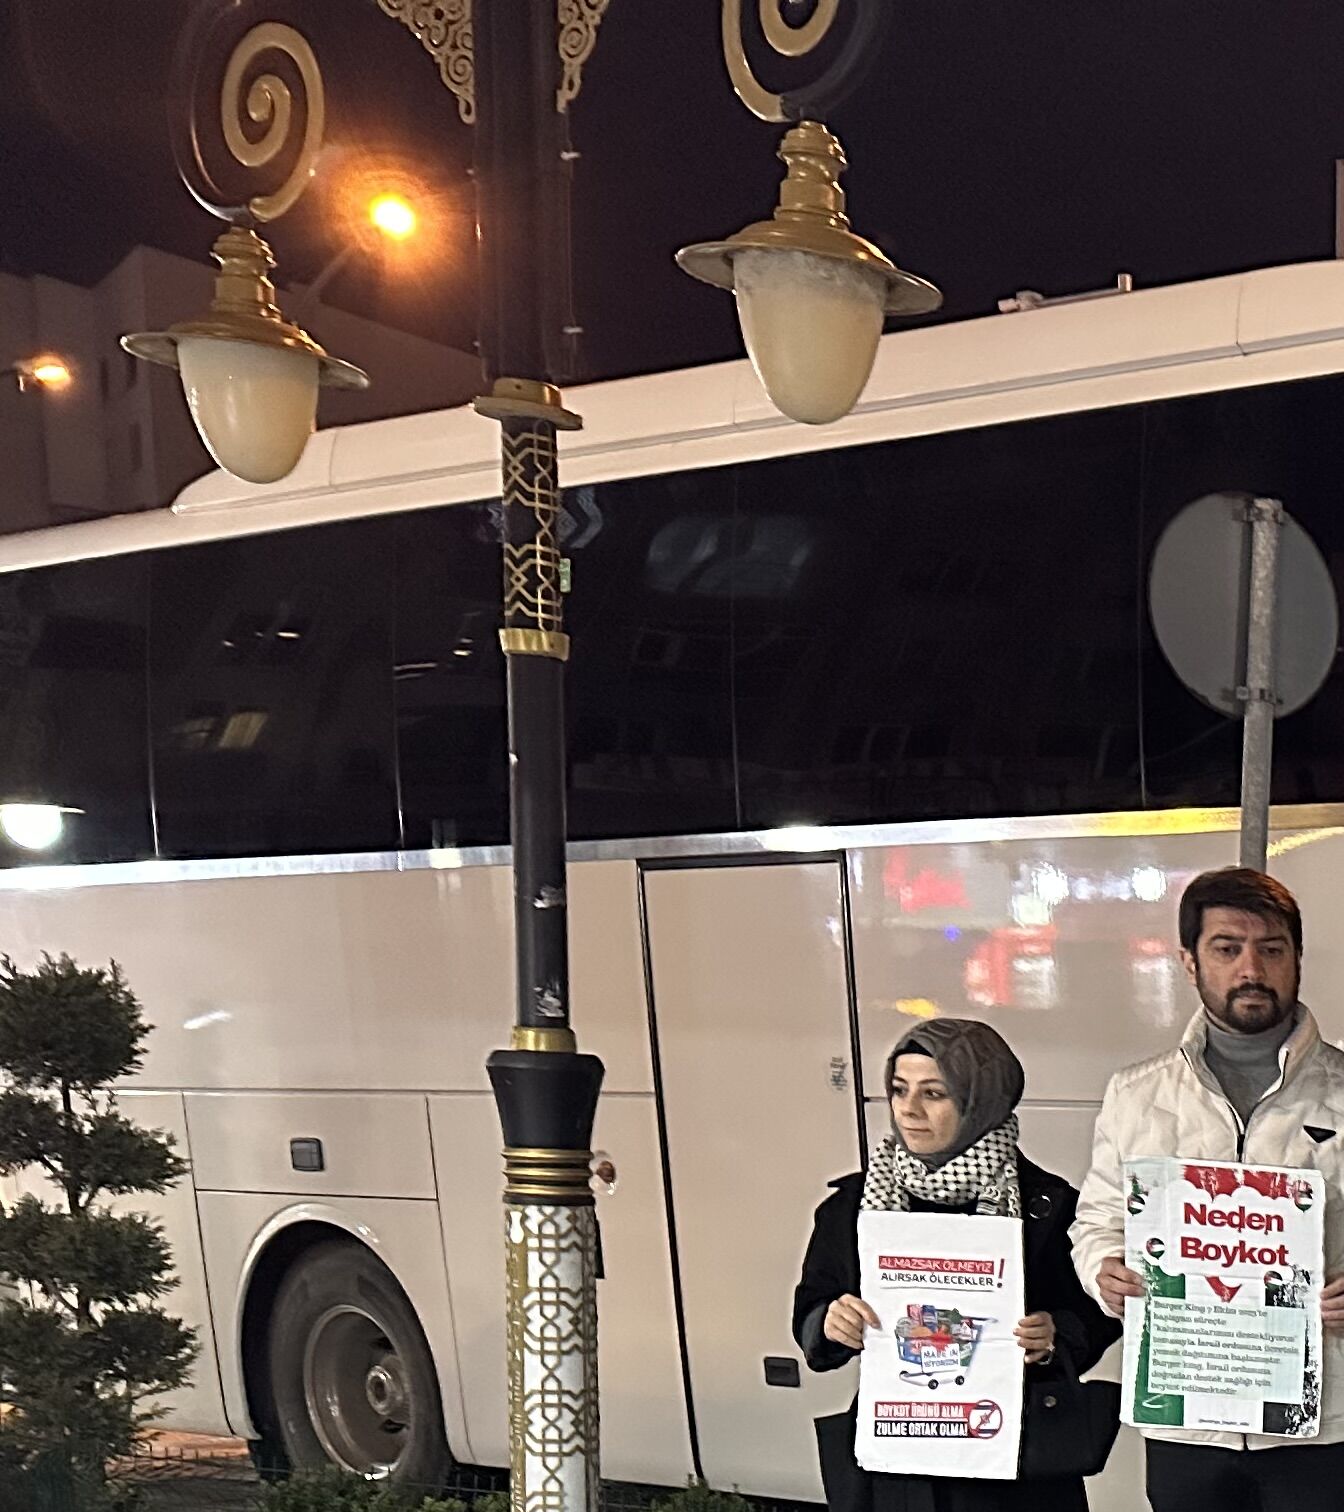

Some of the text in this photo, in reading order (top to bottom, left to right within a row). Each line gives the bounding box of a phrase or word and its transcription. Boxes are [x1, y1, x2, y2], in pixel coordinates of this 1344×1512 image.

[1183, 1202, 1285, 1235] Neden
[1180, 1236, 1290, 1268] Boykot
[881, 1272, 927, 1283] ALIRSAK
